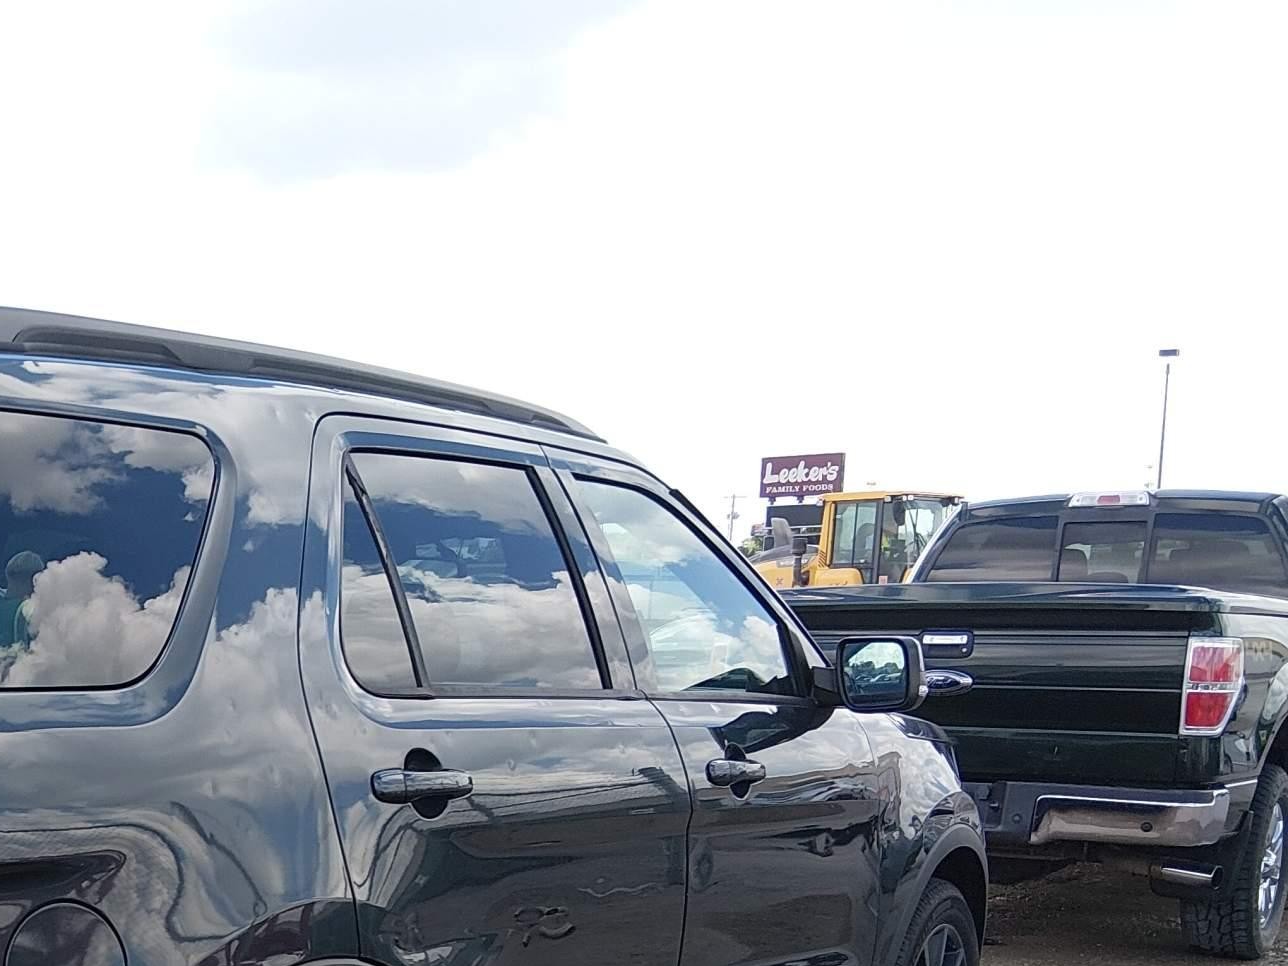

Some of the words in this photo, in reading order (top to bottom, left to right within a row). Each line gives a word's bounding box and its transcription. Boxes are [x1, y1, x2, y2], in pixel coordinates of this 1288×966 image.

[762, 460, 840, 484] Leeker's
[765, 485, 800, 494] FAMILY
[802, 483, 833, 492] FOODS
